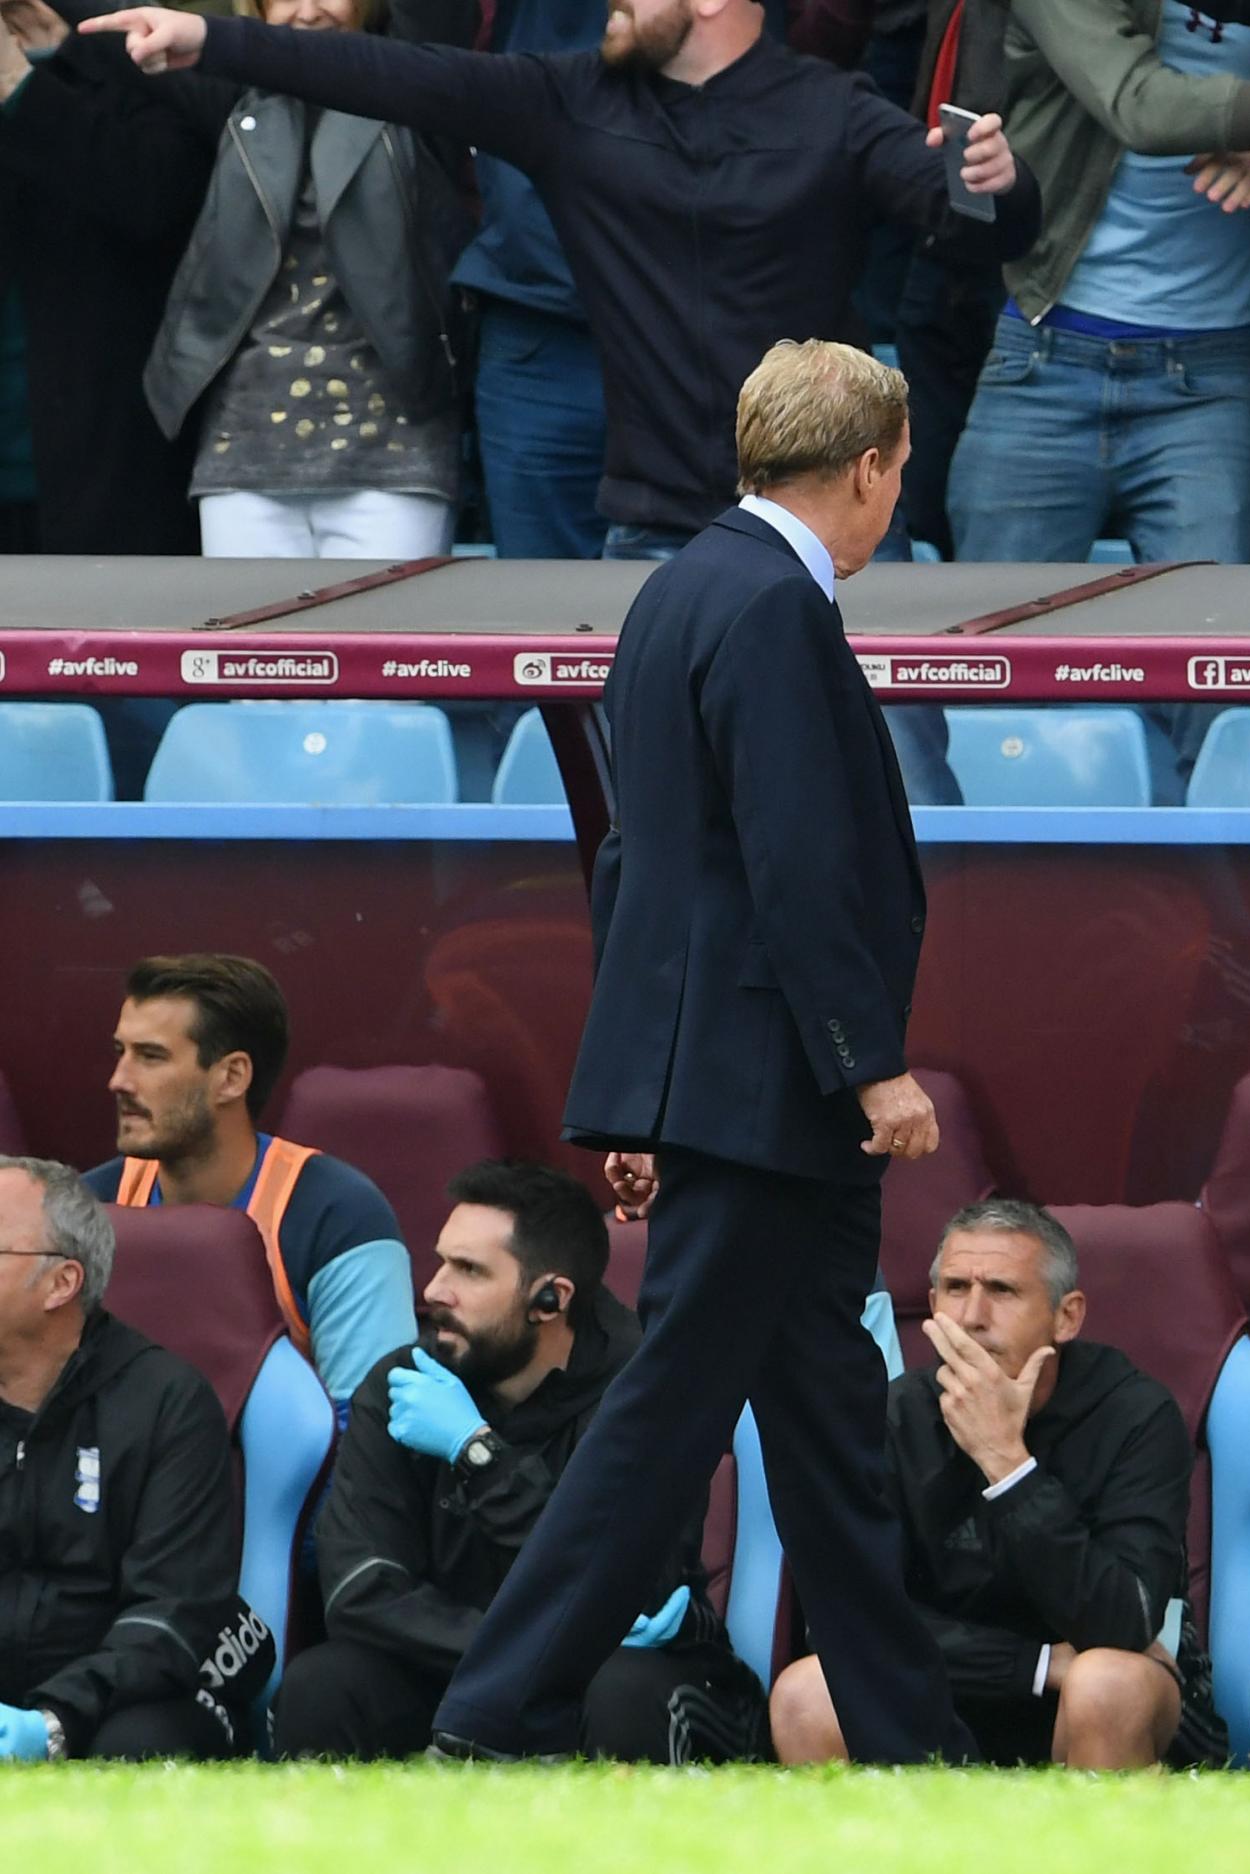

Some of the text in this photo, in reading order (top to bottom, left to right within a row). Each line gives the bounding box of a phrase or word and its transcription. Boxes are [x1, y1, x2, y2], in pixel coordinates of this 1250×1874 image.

[48, 657, 138, 676] #avfclive
[223, 658, 329, 677] avfcofficial
[382, 659, 471, 678] #avfclive
[556, 660, 610, 678] avfco
[896, 662, 1002, 681] avfcofficial
[1054, 663, 1145, 682] #avfclive
